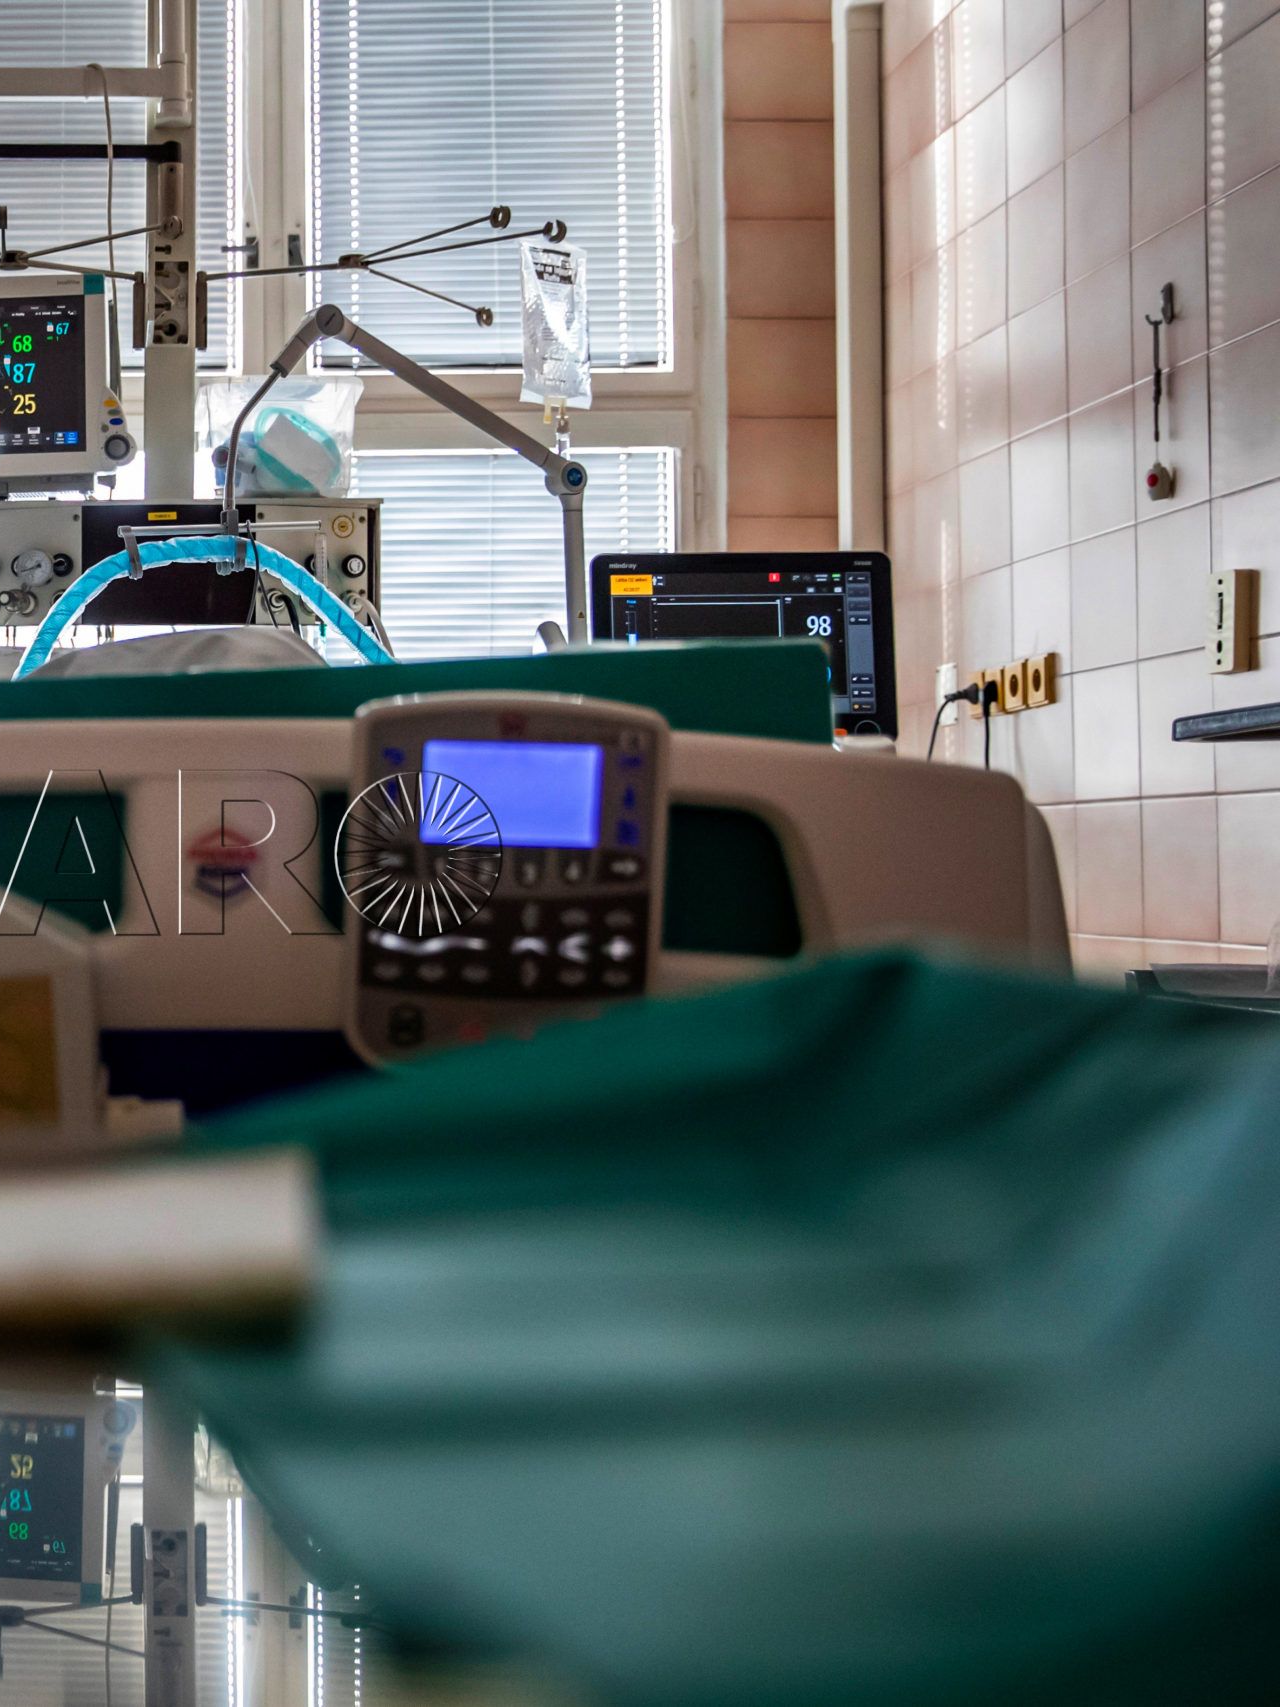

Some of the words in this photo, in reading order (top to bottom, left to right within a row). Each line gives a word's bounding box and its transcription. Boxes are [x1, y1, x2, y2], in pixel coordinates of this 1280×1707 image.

[55, 322, 70, 335] 67
[12, 334, 33, 353] 68
[12, 362, 36, 384] 87
[13, 393, 37, 415] 25
[609, 562, 637, 571] mindray
[806, 615, 832, 636] 98
